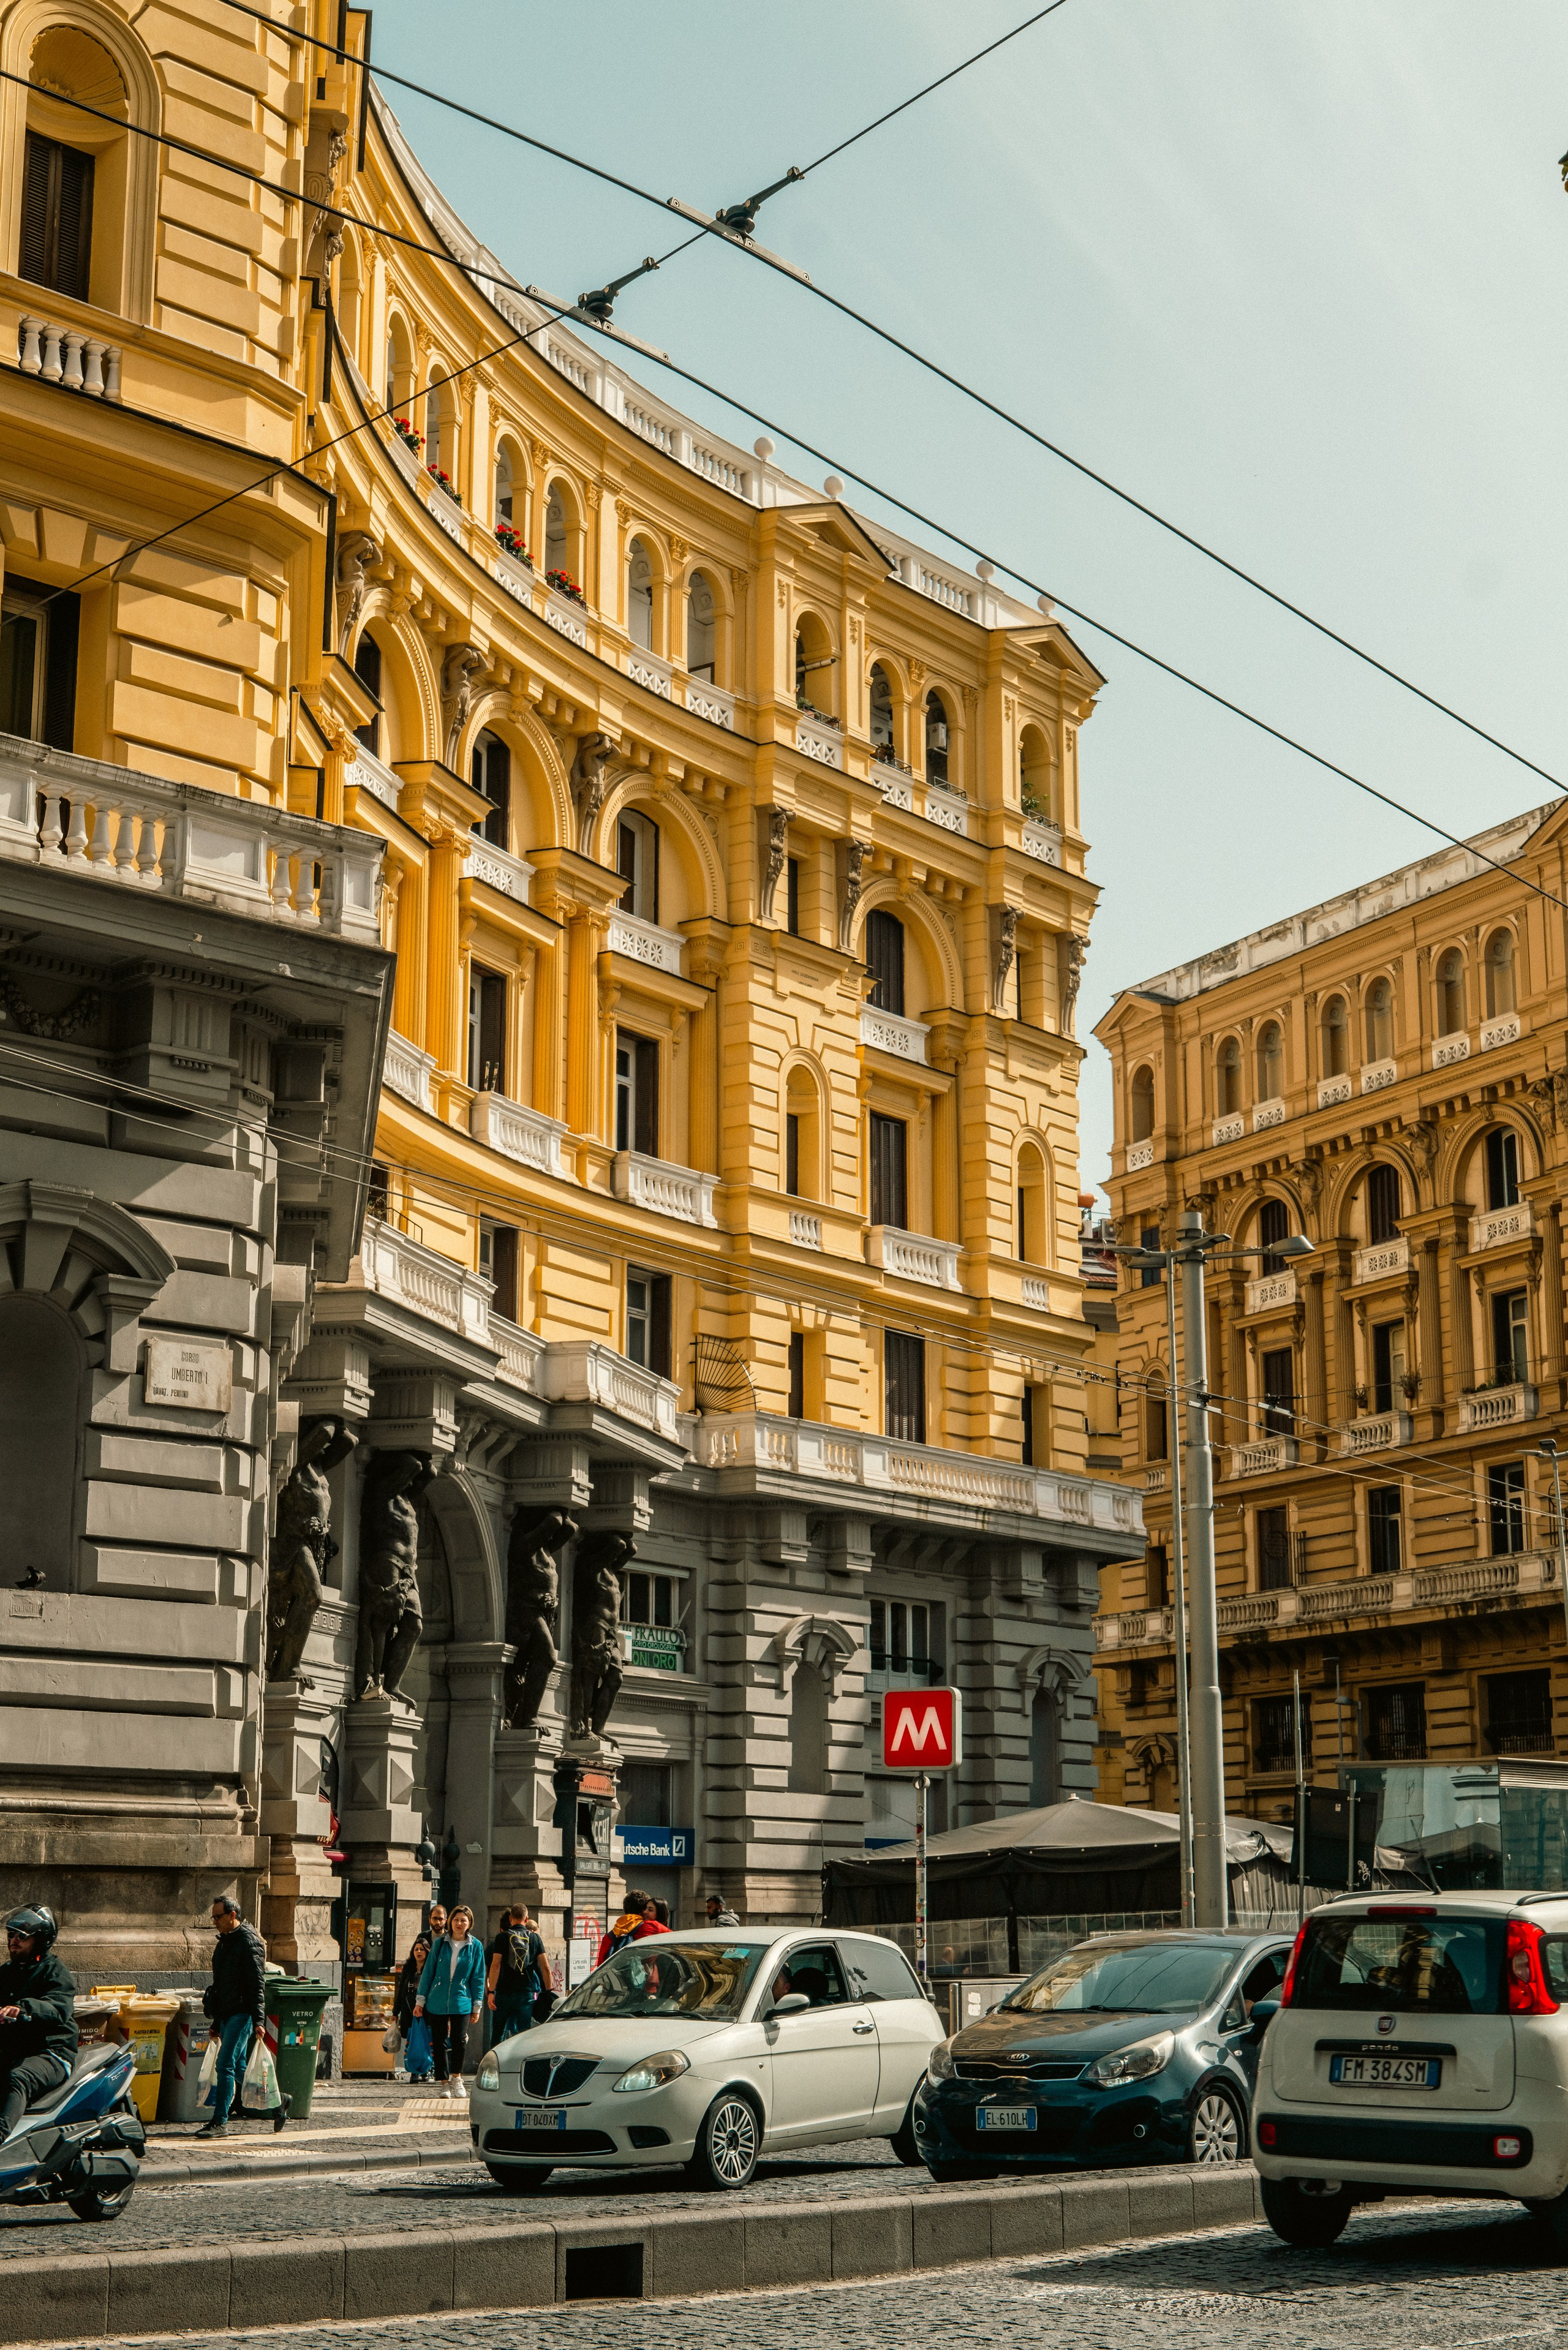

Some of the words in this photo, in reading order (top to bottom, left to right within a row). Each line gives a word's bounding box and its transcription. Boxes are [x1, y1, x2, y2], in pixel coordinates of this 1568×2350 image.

[181, 1351, 199, 1364] CORSO
[172, 1367, 202, 1384] UMBERTO
[205, 1372, 208, 1384] I
[635, 1625, 678, 1643] FRAULO
[633, 1651, 649, 1666] ONI
[652, 1654, 674, 1669] ORO
[891, 1706, 947, 1751] M
[592, 1817, 609, 1843] CCHI
[624, 1842, 649, 1855] utsche
[650, 1843, 670, 1856] Bank
